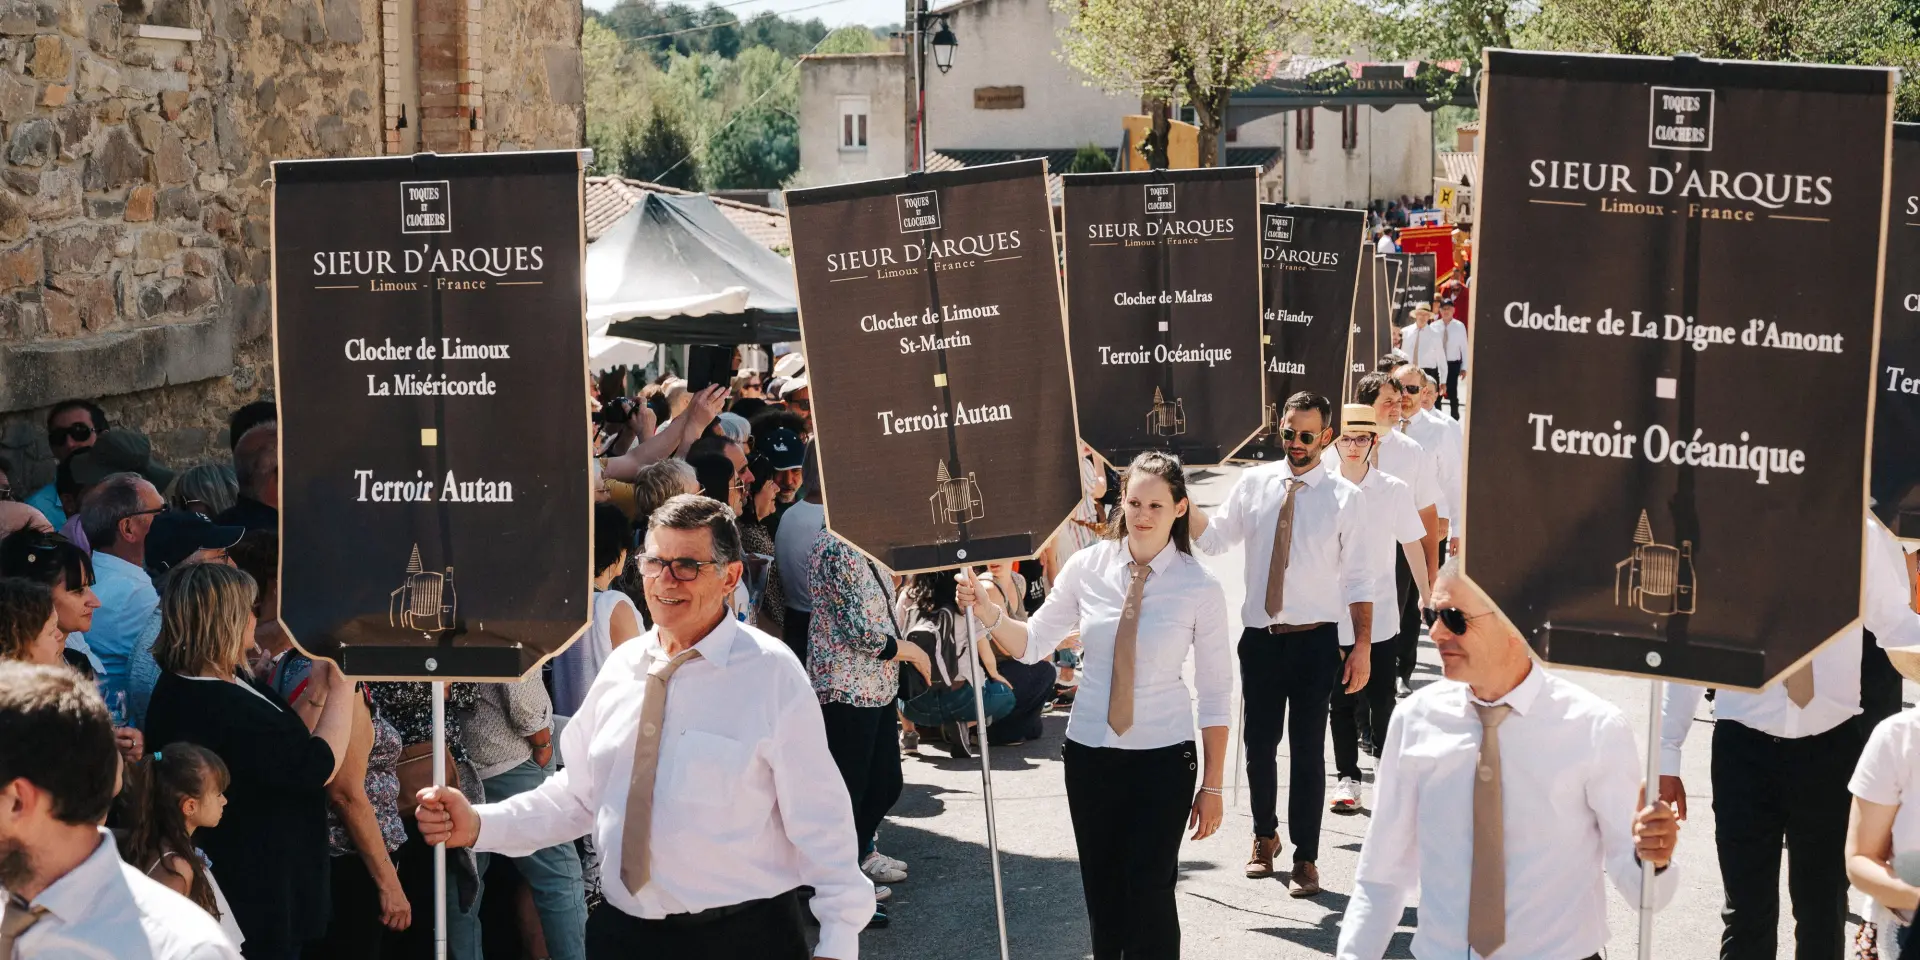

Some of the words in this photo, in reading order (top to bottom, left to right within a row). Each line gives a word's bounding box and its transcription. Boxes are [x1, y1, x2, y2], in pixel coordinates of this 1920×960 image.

[1357, 80, 1375, 90] DE
[1379, 80, 1404, 90] VIN
[1663, 95, 1700, 113] TOQUES
[1676, 115, 1684, 124] ET
[1655, 125, 1704, 142] CLOCHERS
[409, 188, 439, 202] TOQUES
[1529, 160, 1637, 192] SIEUR
[1647, 162, 1832, 210] D'ARQUES
[905, 197, 929, 208] TOQUES
[1601, 198, 1663, 215] Limoux
[1689, 204, 1754, 221] France
[407, 213, 445, 226] CLOCHERS
[904, 215, 935, 227] CLOCHERS
[1089, 223, 1141, 238] SIEUR
[1147, 218, 1234, 237] D'ARQUES
[314, 251, 396, 275] SIEUR
[404, 244, 543, 276] D'ARQUES
[828, 247, 898, 273] SIEUR
[904, 231, 1022, 263] D'ARQUES
[1264, 246, 1339, 266] D'ARQUES
[877, 266, 918, 279] Limoux
[934, 258, 975, 272] France
[371, 280, 417, 291] Limoux
[438, 278, 485, 289] France
[1114, 292, 1156, 305] Clocher
[1159, 291, 1172, 303] de
[1175, 290, 1212, 303] Malras
[861, 312, 917, 332] Clocher
[922, 307, 939, 324] de
[942, 302, 1000, 323] Limoux
[1265, 308, 1275, 320] de
[1277, 310, 1313, 326] Flandry
[1504, 302, 1591, 333] Clocher
[1597, 308, 1625, 335] de
[1630, 311, 1658, 338] La
[1663, 315, 1735, 351] Digne
[1741, 319, 1843, 353] d'Amont
[345, 338, 412, 361] Clocher
[416, 337, 436, 360] de
[442, 338, 510, 359] Limoux
[900, 331, 971, 354] St-Martin
[1099, 345, 1150, 364] Terroir
[1154, 343, 1231, 367] Océanique
[1268, 356, 1305, 374] Autan
[367, 375, 390, 396] La
[394, 372, 496, 395] Miséricorde
[878, 405, 948, 435] Terroir
[954, 402, 1012, 426] Autan
[1528, 413, 1636, 458] Terroir
[1644, 425, 1805, 484] Océanique
[354, 470, 433, 502] Terroir
[439, 470, 513, 502] Autan
